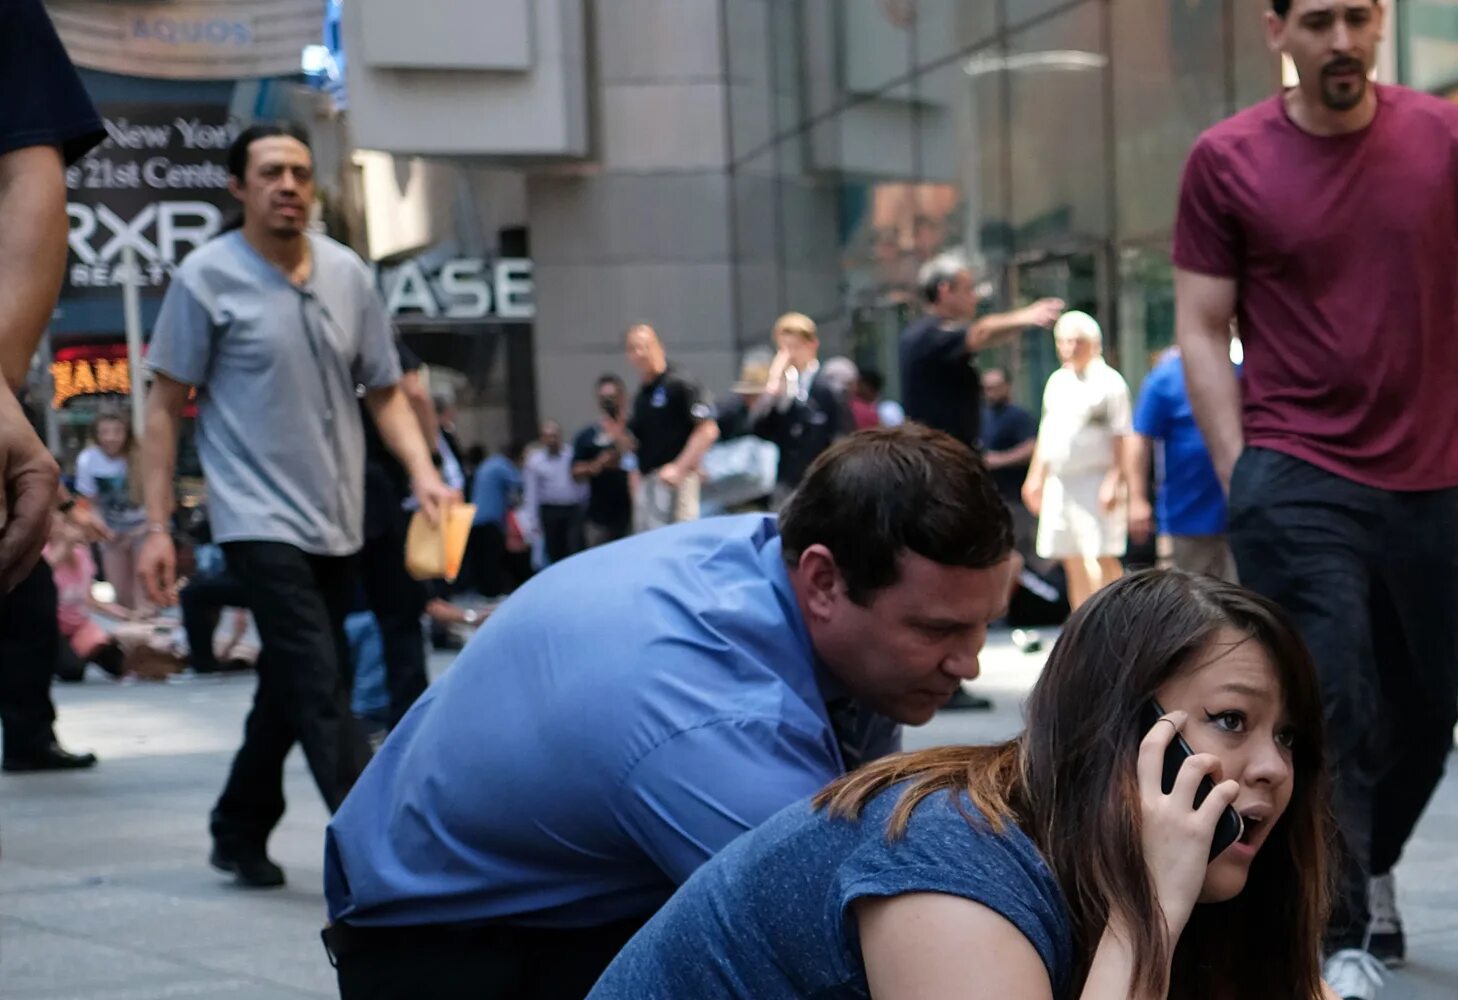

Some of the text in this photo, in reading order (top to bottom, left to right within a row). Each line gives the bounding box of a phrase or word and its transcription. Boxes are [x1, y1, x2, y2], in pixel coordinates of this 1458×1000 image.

[103, 117, 171, 149] New
[143, 156, 229, 189] Centu
[66, 201, 222, 266] RXR
[386, 259, 535, 318] ASE
